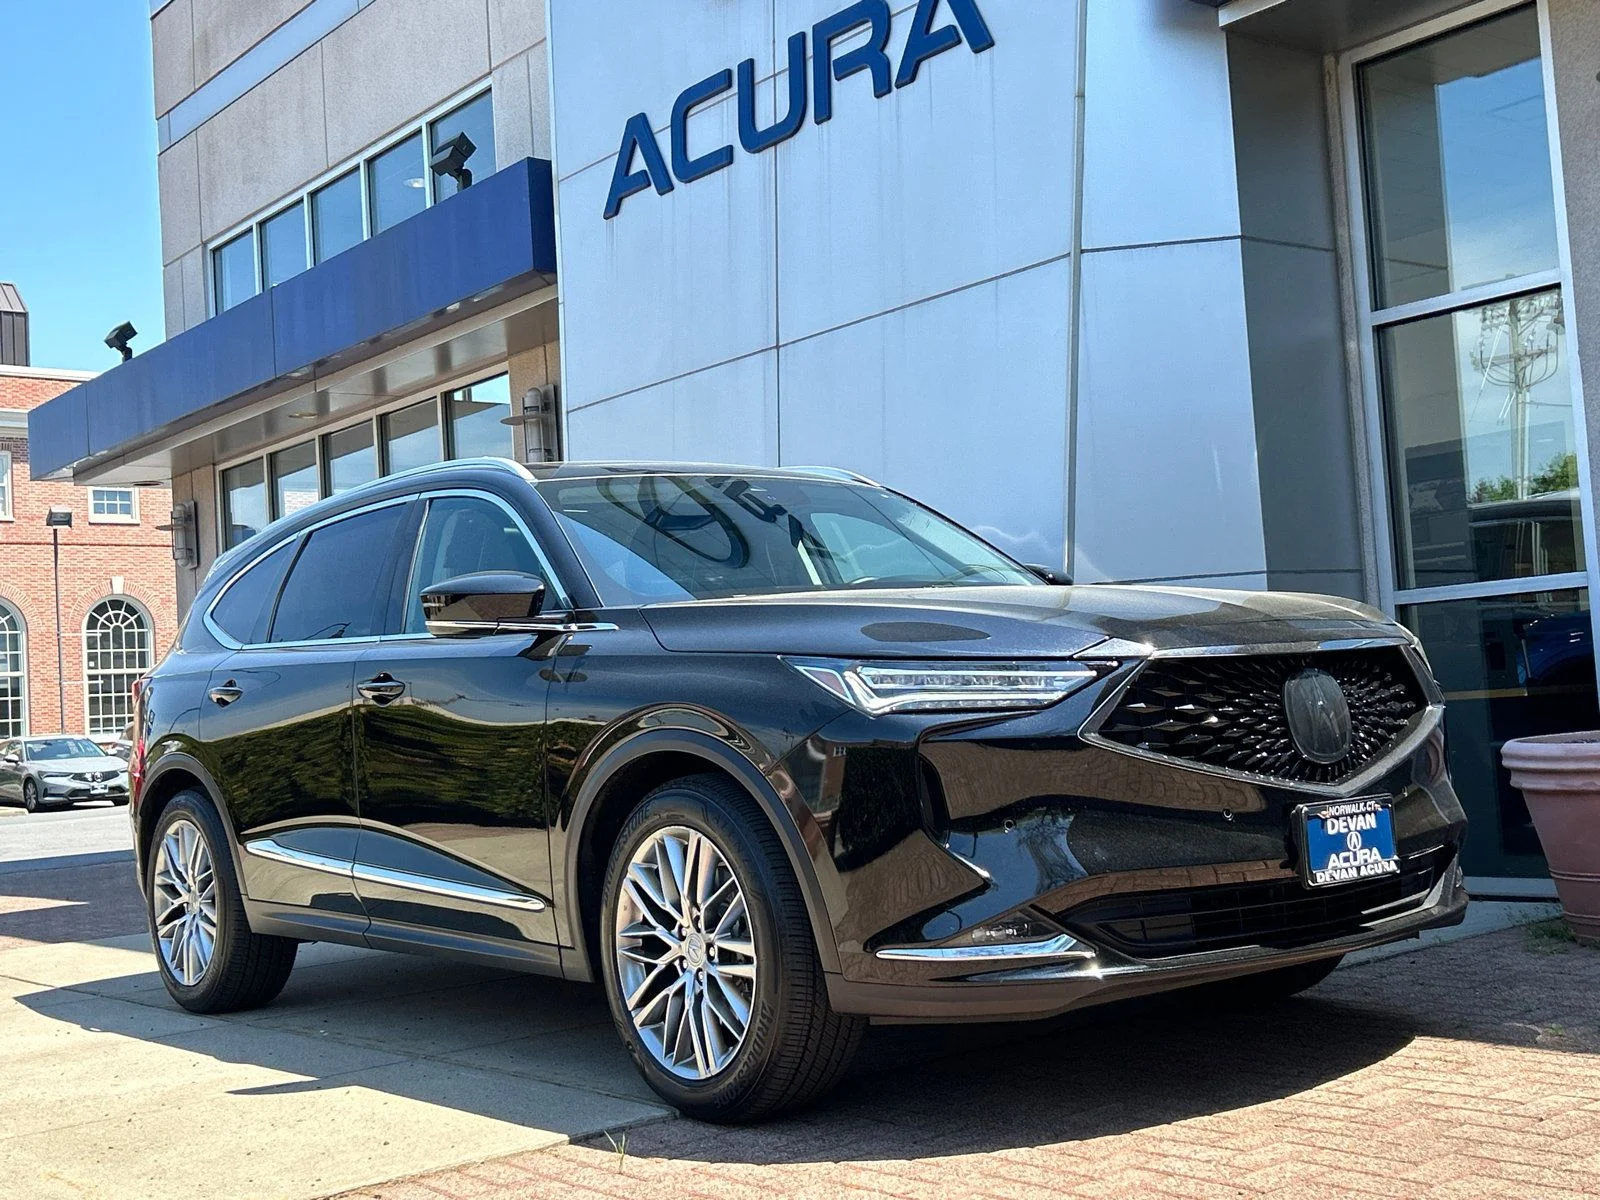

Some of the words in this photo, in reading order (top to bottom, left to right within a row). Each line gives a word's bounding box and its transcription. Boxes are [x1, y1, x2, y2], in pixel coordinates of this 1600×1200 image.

[602, 0, 996, 220] ACURA
[1366, 800, 1376, 812] CT
[1326, 812, 1377, 835] DEVAN
[1327, 847, 1381, 869] ACURA
[1316, 867, 1358, 883] DEVAN
[1360, 860, 1397, 877] ACURA
